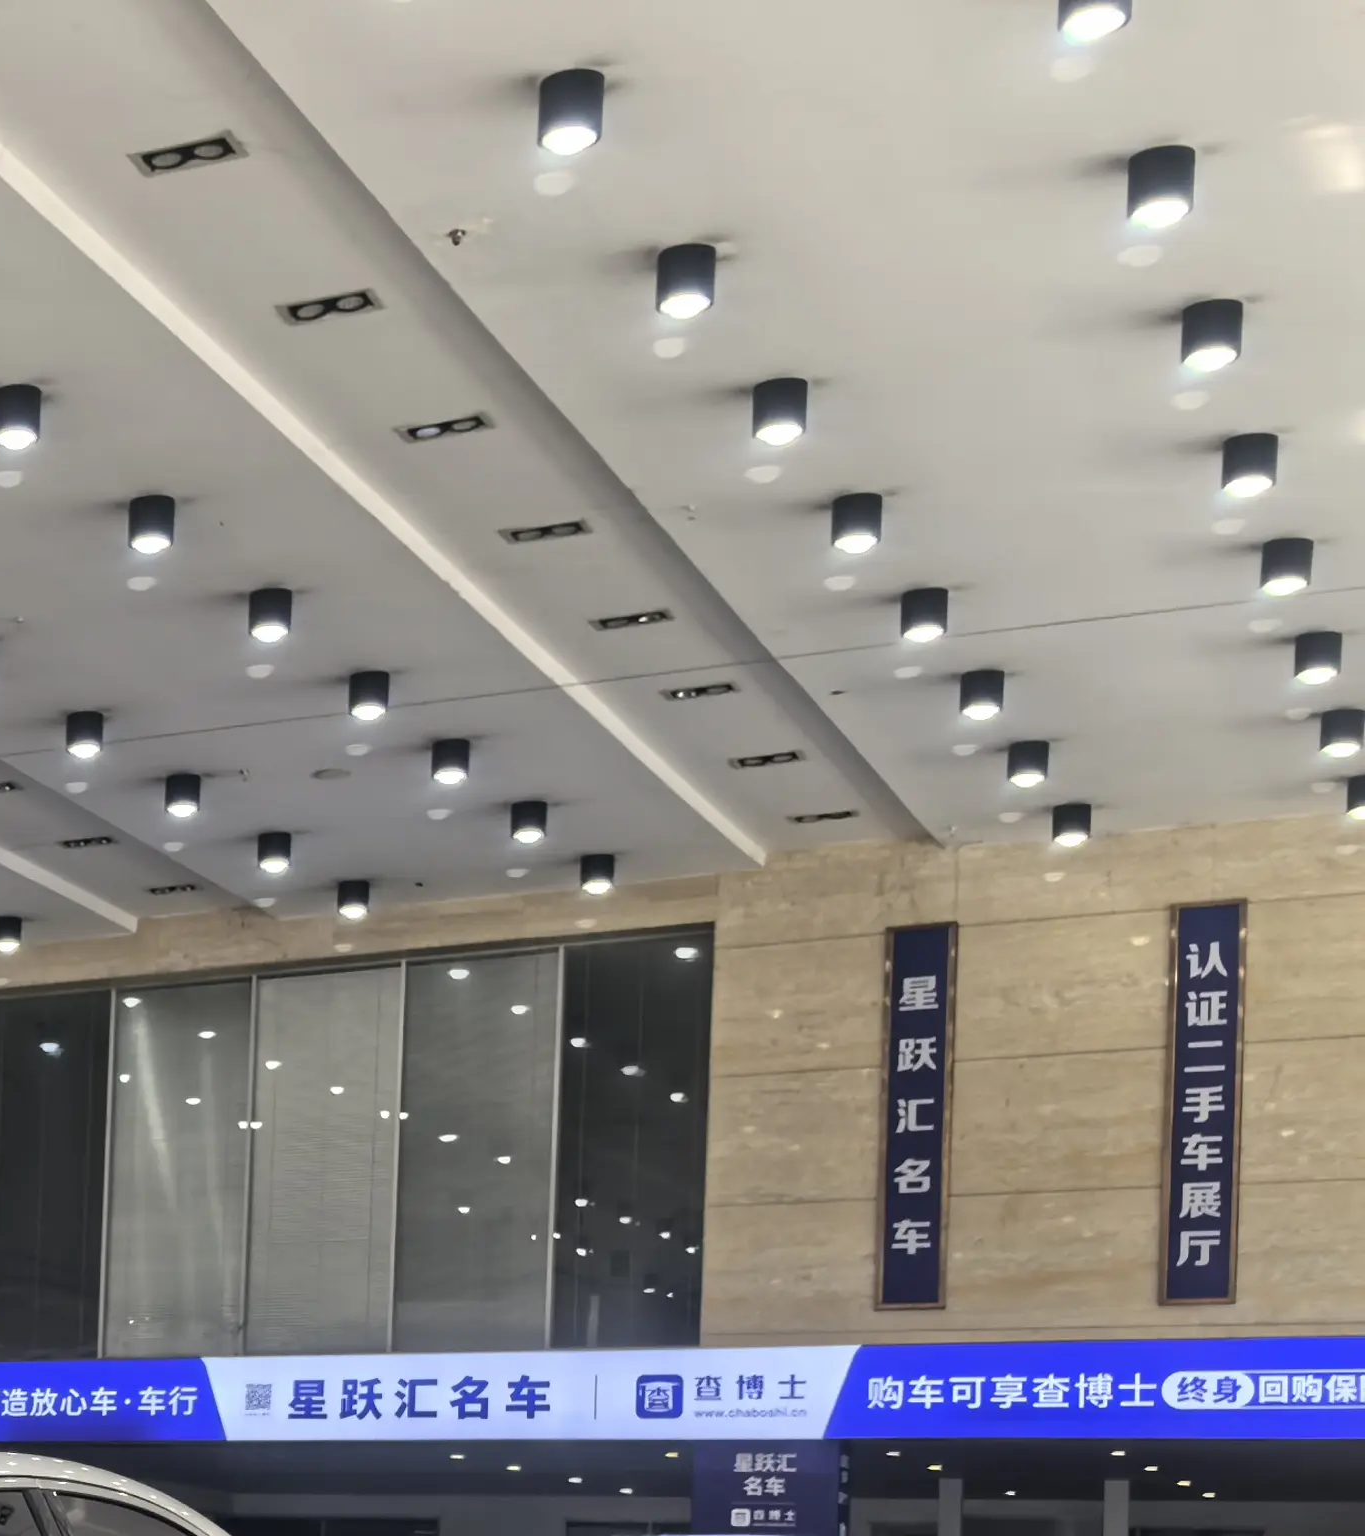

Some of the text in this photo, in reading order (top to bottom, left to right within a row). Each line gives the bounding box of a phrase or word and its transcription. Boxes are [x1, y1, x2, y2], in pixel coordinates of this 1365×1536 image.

[890, 974, 939, 1256] 星跃汇名车
[1176, 940, 1229, 1268] 认证二手车展厅
[287, 1374, 551, 1420] 星跃汇名车
[693, 1373, 808, 1401] 查博士
[1258, 1373, 1365, 1405] 回购保
[692, 1406, 808, 1419] www.chaboshi.cn
[732, 1452, 798, 1473] 星跃汇
[742, 1475, 786, 1497] 名车
